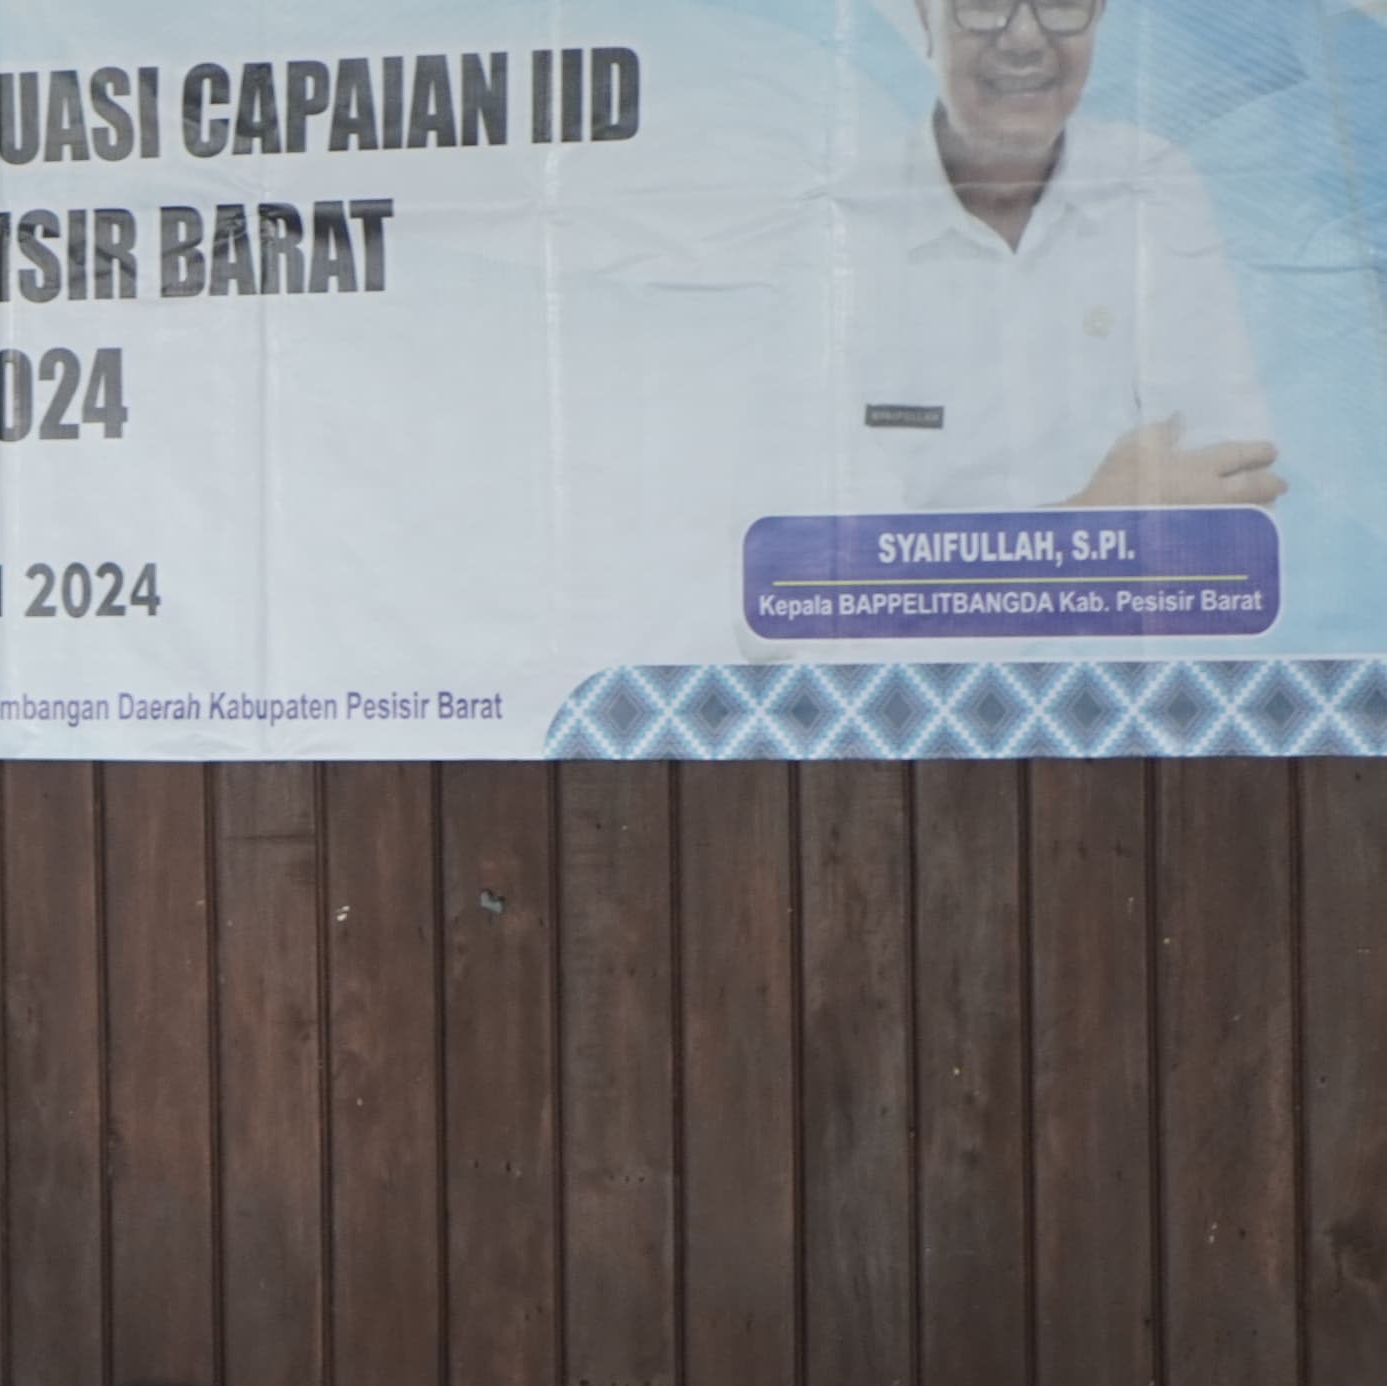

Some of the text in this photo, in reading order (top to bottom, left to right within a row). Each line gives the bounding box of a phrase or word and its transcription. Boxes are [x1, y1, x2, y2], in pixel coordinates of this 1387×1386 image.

[182, 52, 509, 158] CAPAIAN
[531, 47, 640, 144] IID
[159, 198, 394, 298] BARAT
[878, 530, 1136, 567] SYAIFULLAH, S.PI.
[24, 562, 161, 618] 2024
[758, 588, 1263, 620] Kepala BAPPELITBANGDA Kab. Pesisir Barat
[118, 693, 201, 720] Daerah
[209, 692, 338, 727] Kabupaten
[346, 692, 431, 720] Pesisir
[437, 691, 503, 719] Barat
